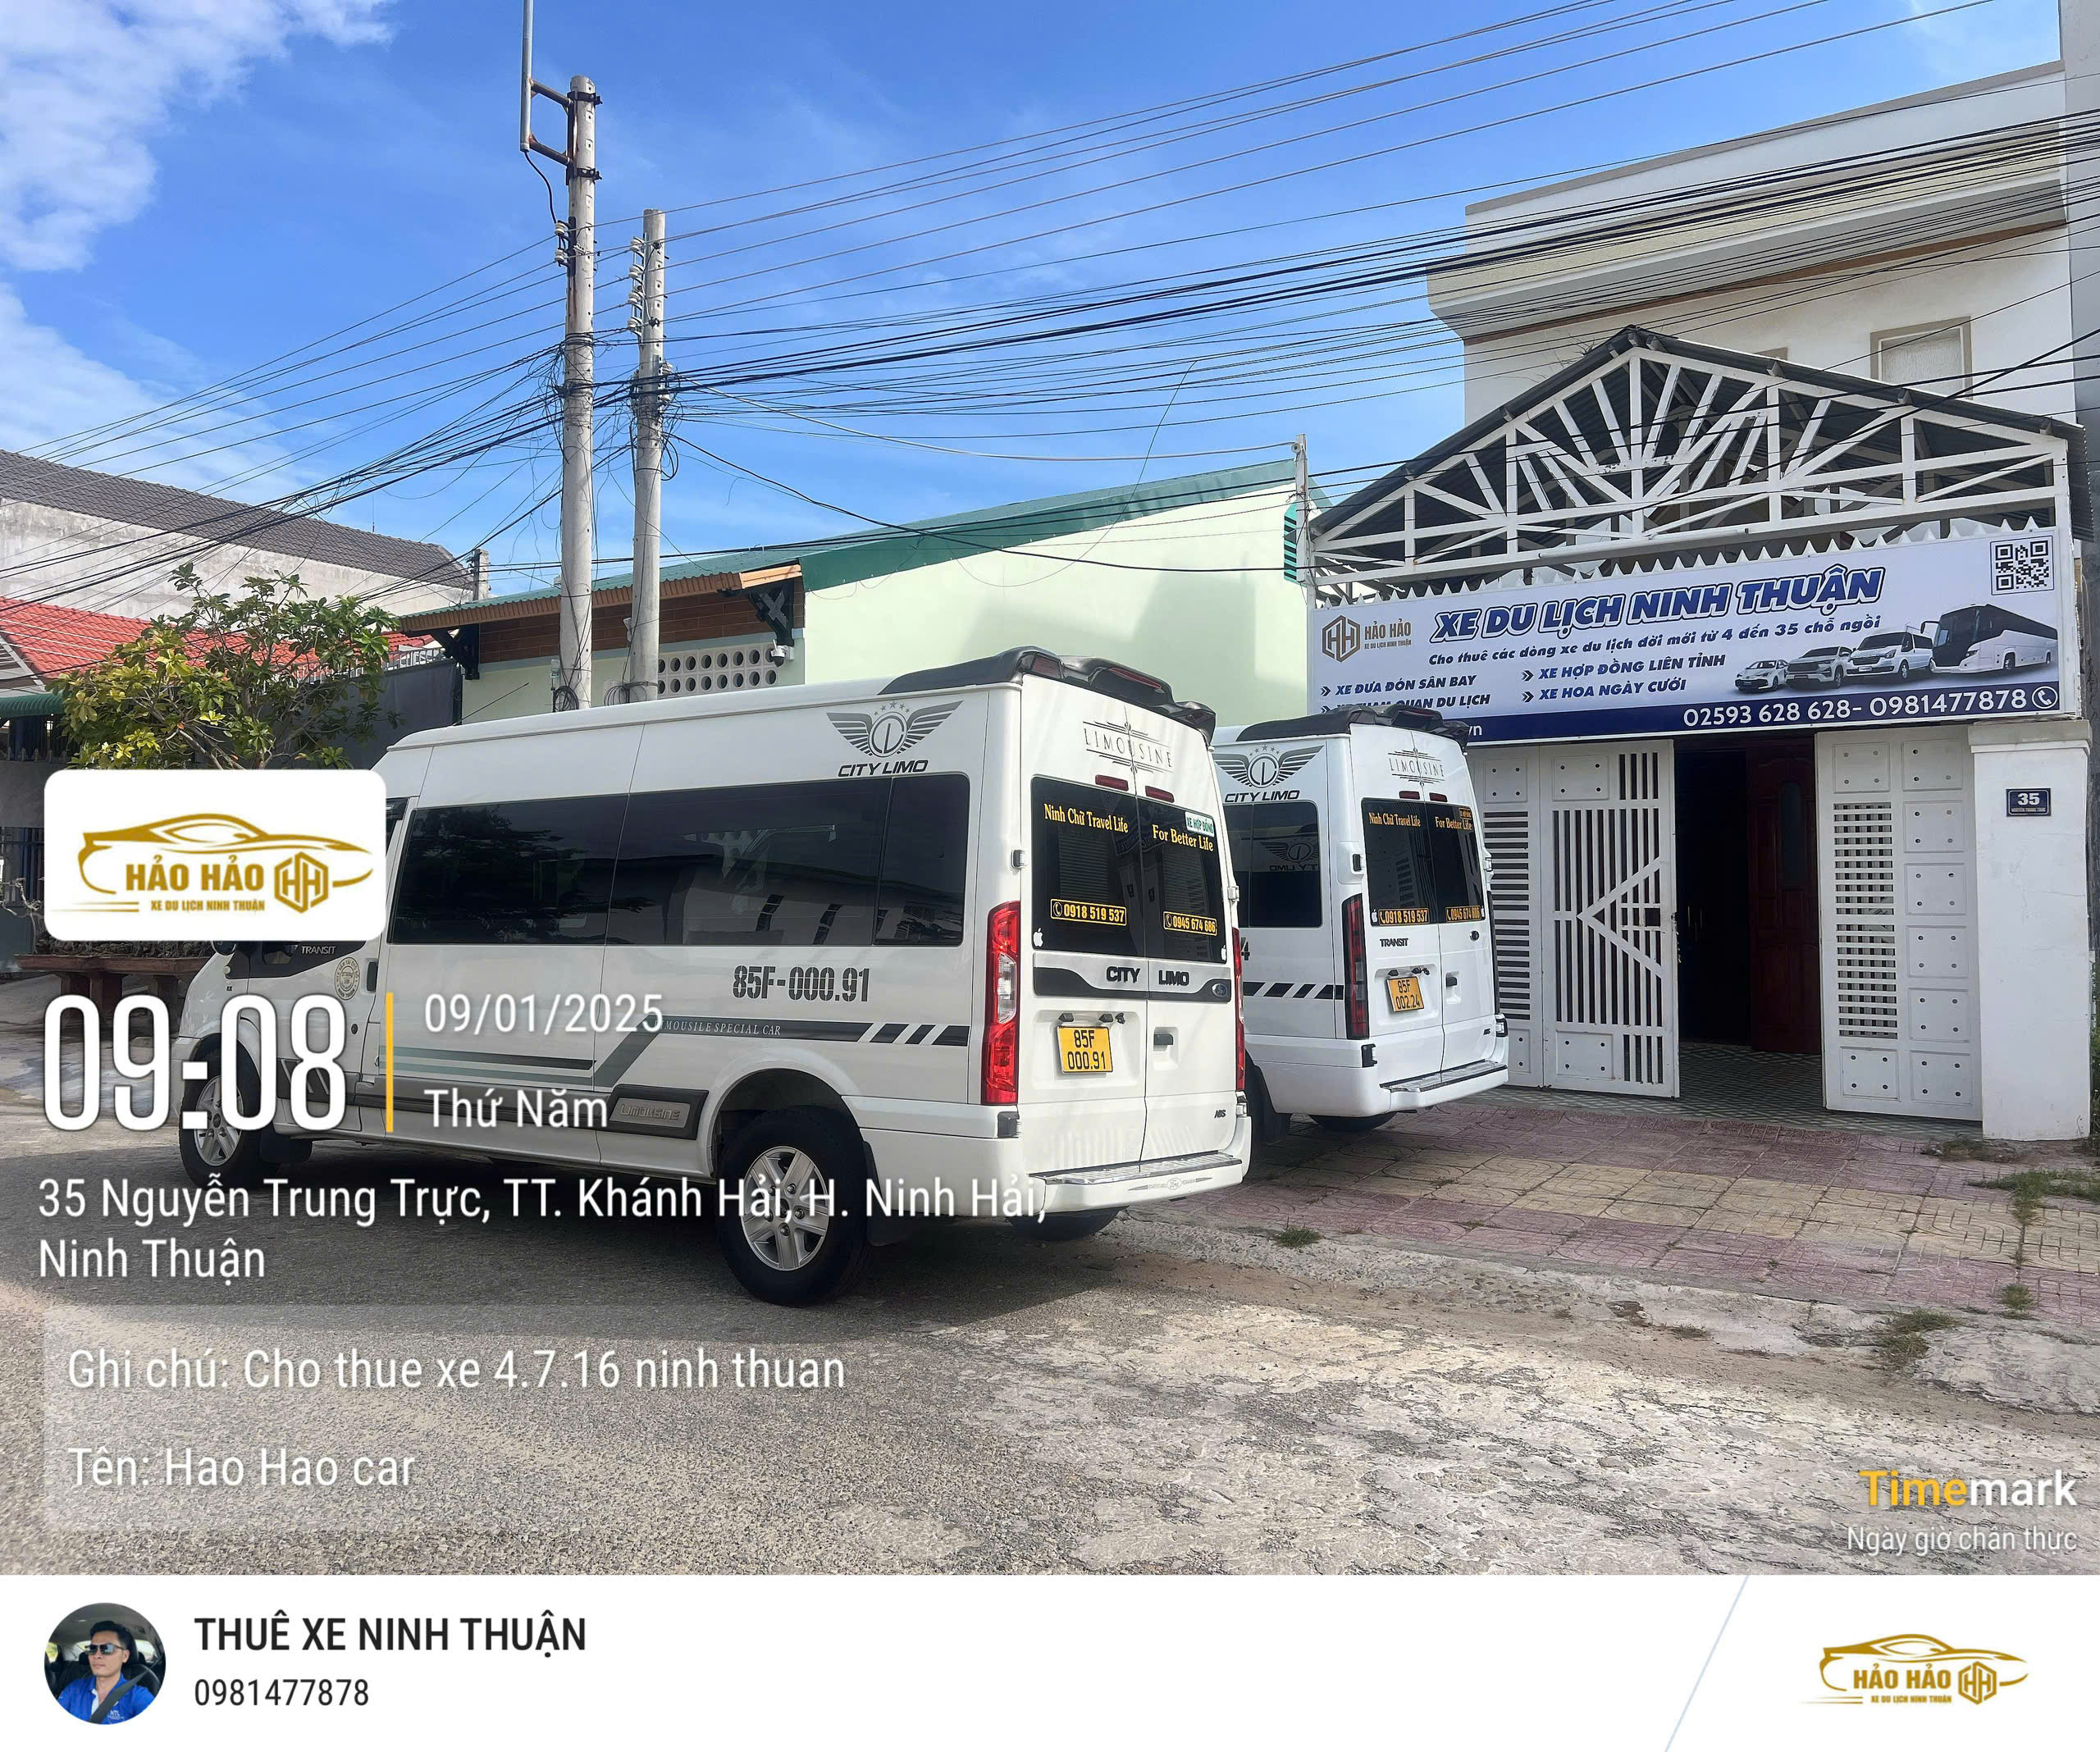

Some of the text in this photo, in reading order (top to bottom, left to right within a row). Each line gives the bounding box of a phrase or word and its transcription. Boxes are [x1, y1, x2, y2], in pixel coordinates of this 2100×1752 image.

[1432, 565, 1883, 640] XE DU LỊCH NINH THUẬN
[1365, 618, 1411, 640] HẢO HẢO
[1429, 614, 1880, 665] Cho thuê các dòng xe du lịch đời mới từ 4 đến 35 chỗ ngồi
[1538, 652, 1726, 680] XE HỢP ĐỒNG LIÊN TỈNH
[1335, 675, 1477, 696] XE ĐƯA ĐÓN SÂN BAY
[1539, 677, 1687, 700] XE HOA NGÀY CƯỚI
[1436, 696, 1456, 708] DU
[1459, 694, 1491, 709] LỊCH
[1683, 705, 1752, 727] 02593
[1759, 702, 1800, 723] 628
[1869, 688, 2027, 716] 0981477878
[1084, 728, 1172, 768] LIMOUSINE
[838, 760, 929, 778] CITY LIMO
[1389, 758, 1444, 777] LIMOUSINE
[1225, 790, 1300, 803] CITY LIMO
[2018, 793, 2040, 805] 35
[1043, 803, 1066, 824] Ninh
[1086, 811, 1112, 830] Travel
[1113, 815, 1129, 833] Life
[1435, 816, 1445, 828] For
[1445, 817, 1462, 828] Better
[1153, 824, 1214, 852] For Better Life
[1064, 903, 1125, 923] 0918 519 537
[1385, 909, 1428, 924] 0918 519 537
[1173, 915, 1216, 933] 0945 674 686
[301, 946, 336, 955] TRANSIT
[1380, 938, 1408, 947] TRANSIT
[733, 965, 870, 1002] 85F-000.91
[1107, 966, 1189, 987] CITY LIMO
[1397, 979, 1411, 993] 85F
[1395, 994, 1421, 1010] 002.24
[714, 1023, 759, 1034] SPECIAL
[762, 1025, 781, 1035] CAR
[1074, 1029, 1095, 1048] 85F
[1067, 1051, 1107, 1070] 000.91
